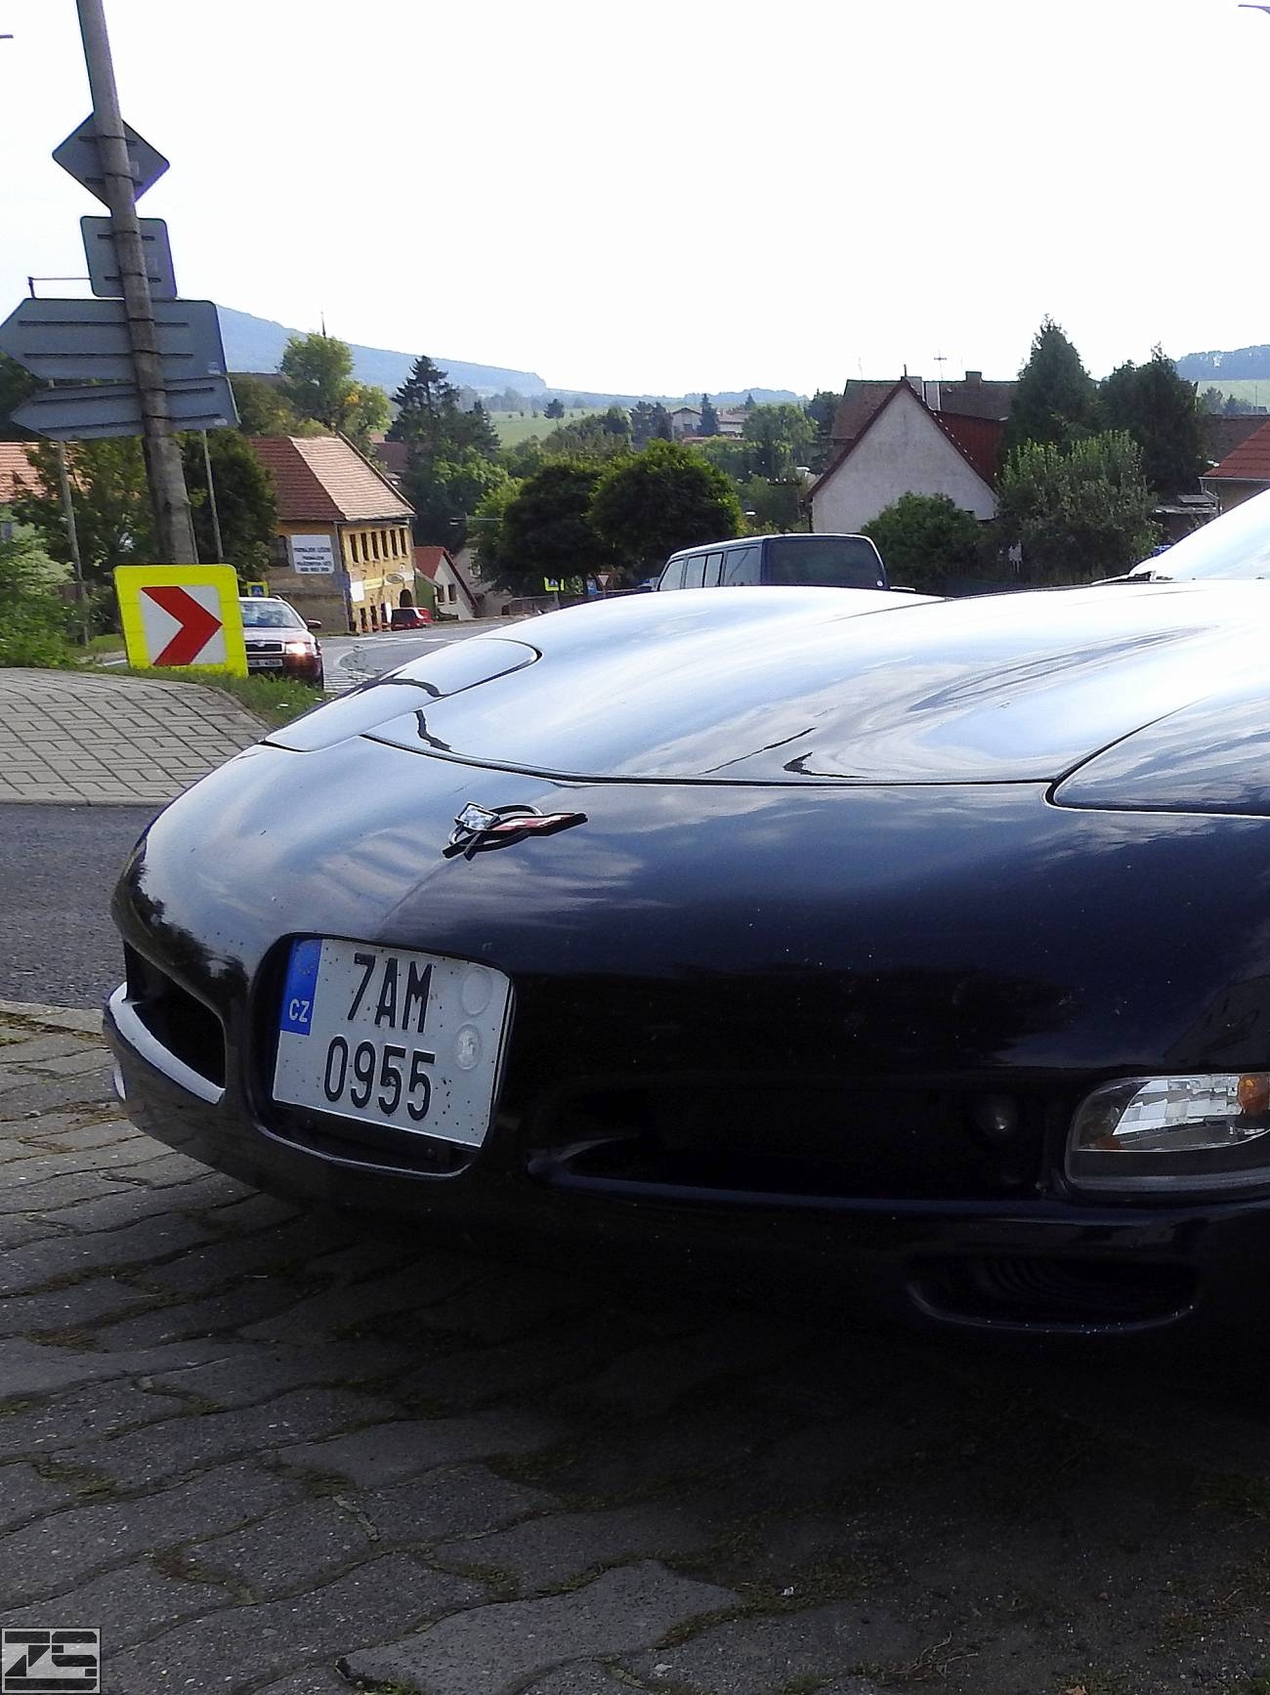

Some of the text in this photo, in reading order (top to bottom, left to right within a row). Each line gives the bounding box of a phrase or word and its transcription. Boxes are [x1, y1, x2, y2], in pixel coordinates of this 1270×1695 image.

[288, 998, 310, 1023] CZ
[347, 952, 433, 1034] 7AM
[323, 1035, 436, 1121] 0955
